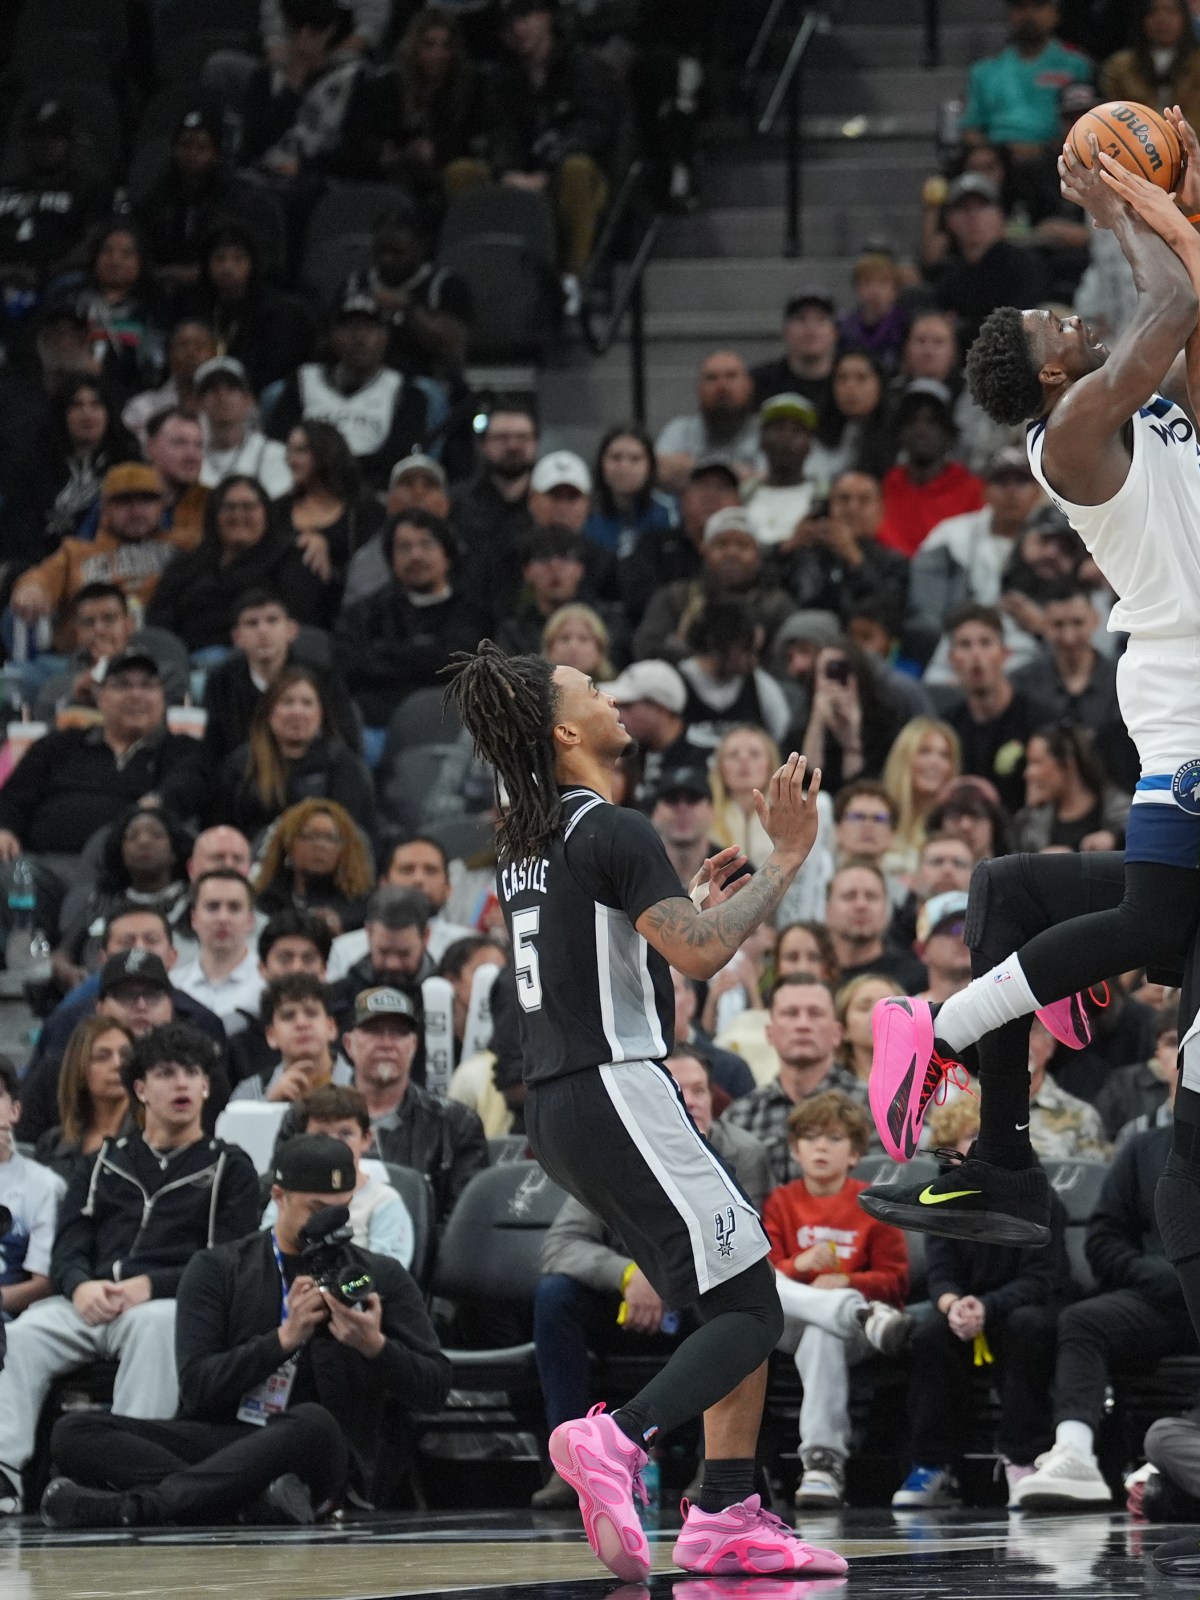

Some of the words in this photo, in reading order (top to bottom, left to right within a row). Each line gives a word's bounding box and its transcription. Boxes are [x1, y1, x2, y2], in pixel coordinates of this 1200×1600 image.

[1110, 105, 1163, 172] Wilson
[1173, 760, 1200, 792] MINNESOTA
[501, 855, 550, 903] CASTLE
[511, 905, 543, 1014] 5
